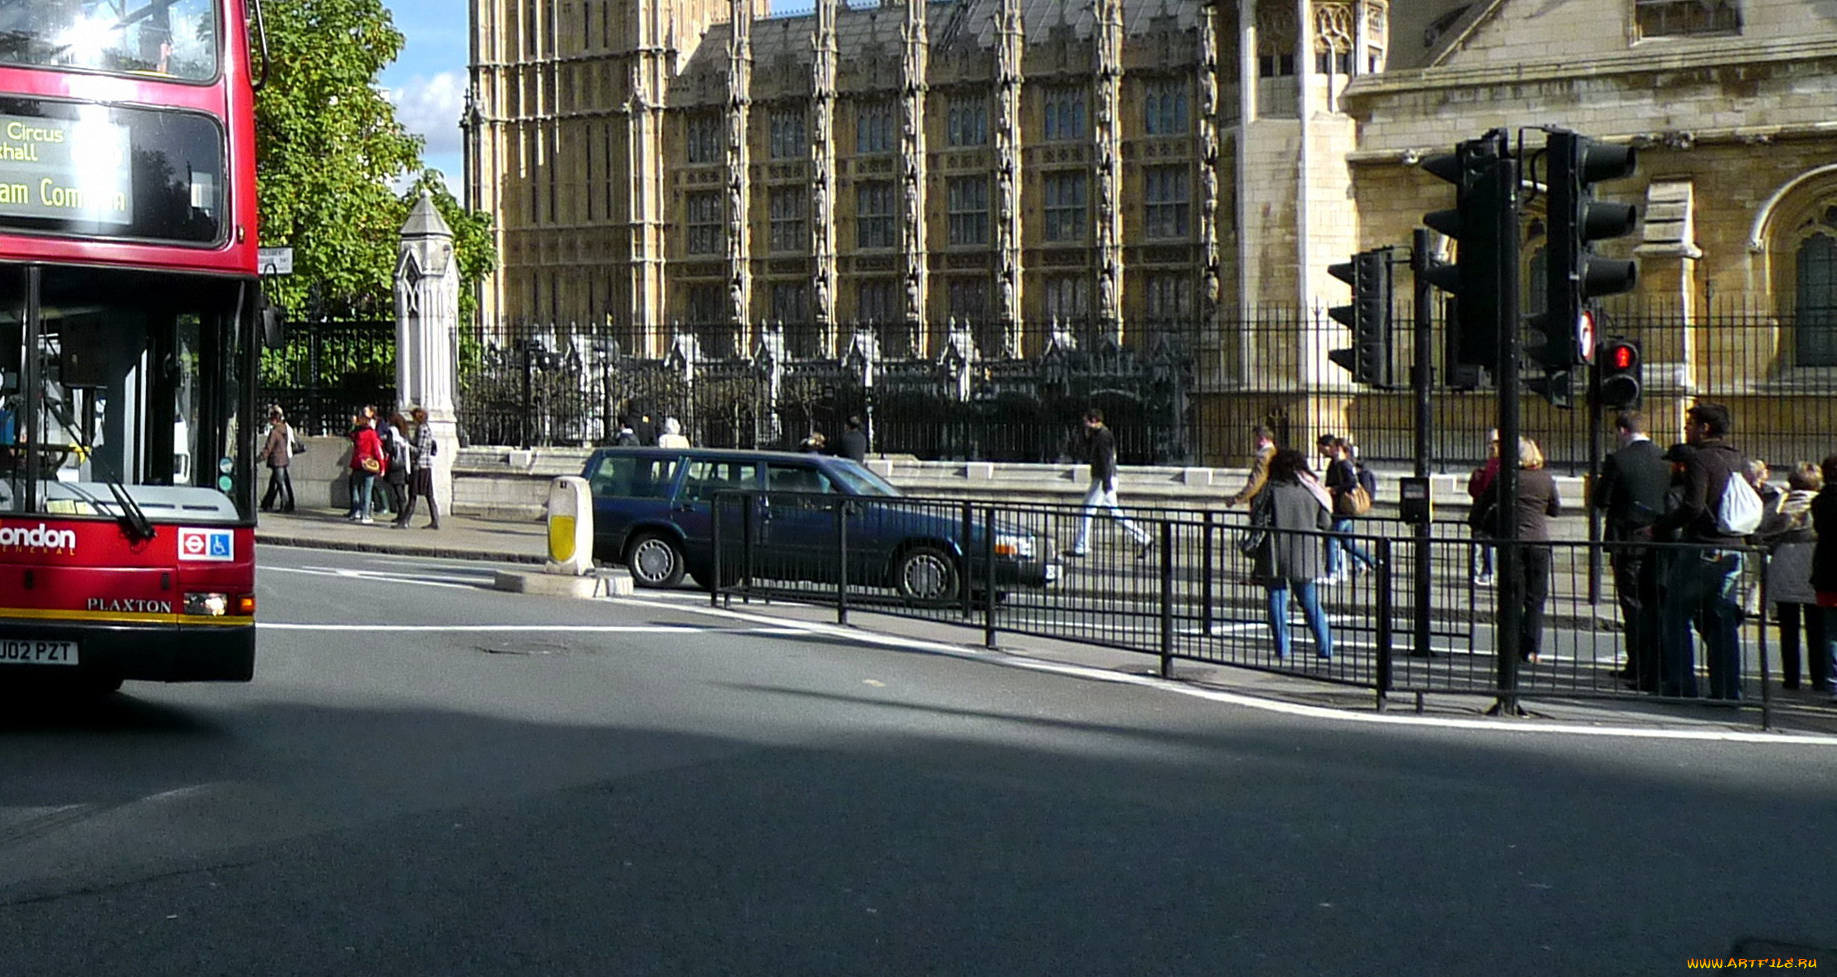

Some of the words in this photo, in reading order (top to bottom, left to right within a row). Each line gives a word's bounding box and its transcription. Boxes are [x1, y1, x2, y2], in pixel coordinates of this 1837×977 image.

[7, 122, 64, 143] Circus
[40, 178, 126, 212] Comn
[87, 597, 172, 613] PLAXTON
[35, 642, 72, 662] PZT
